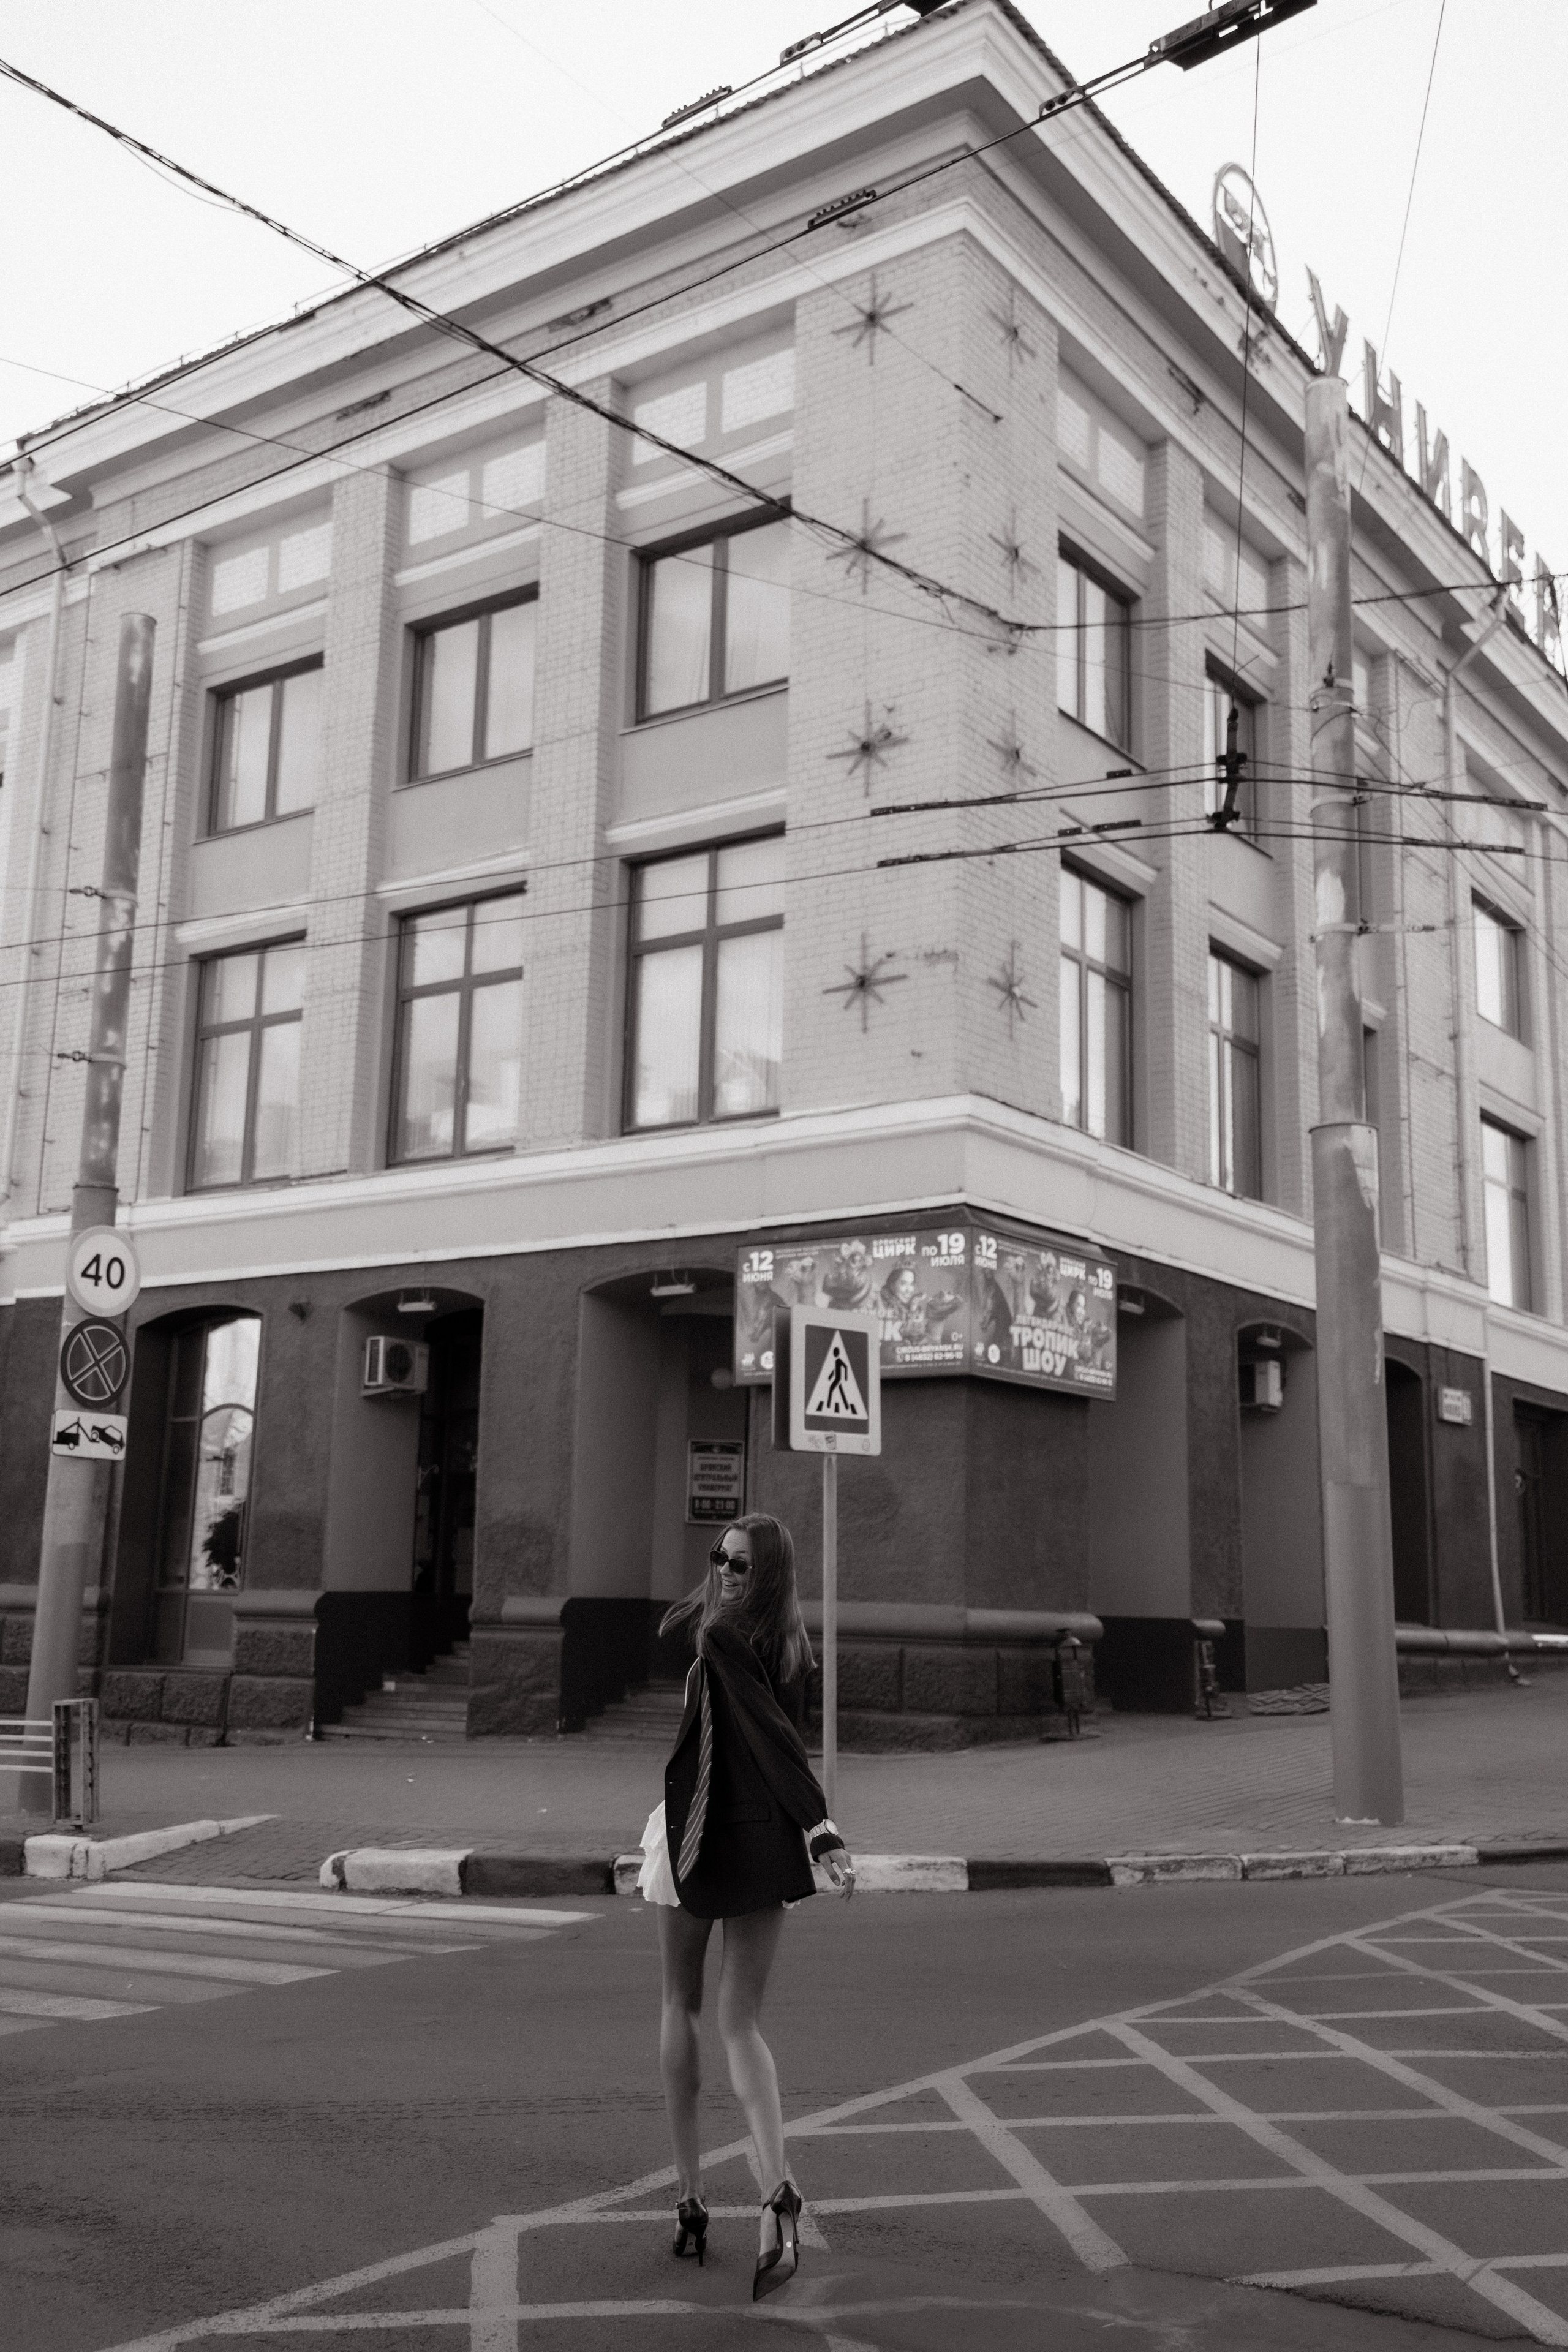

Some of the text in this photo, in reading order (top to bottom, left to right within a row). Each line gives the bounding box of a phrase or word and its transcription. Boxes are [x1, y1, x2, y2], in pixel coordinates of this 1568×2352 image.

[873, 1243, 916, 1259] ЦИРК
[937, 1232, 966, 1255] 19
[979, 1235, 997, 1259] 12
[81, 1253, 126, 1289] 40
[749, 1250, 774, 1272] 12
[930, 1254, 965, 1267] ИЮЛЯ
[742, 1271, 774, 1283] ИЮНЯ
[1096, 1267, 1113, 1289] 19
[1009, 1325, 1079, 1359] ТРОПИК
[1022, 1348, 1067, 1377] ШОУ
